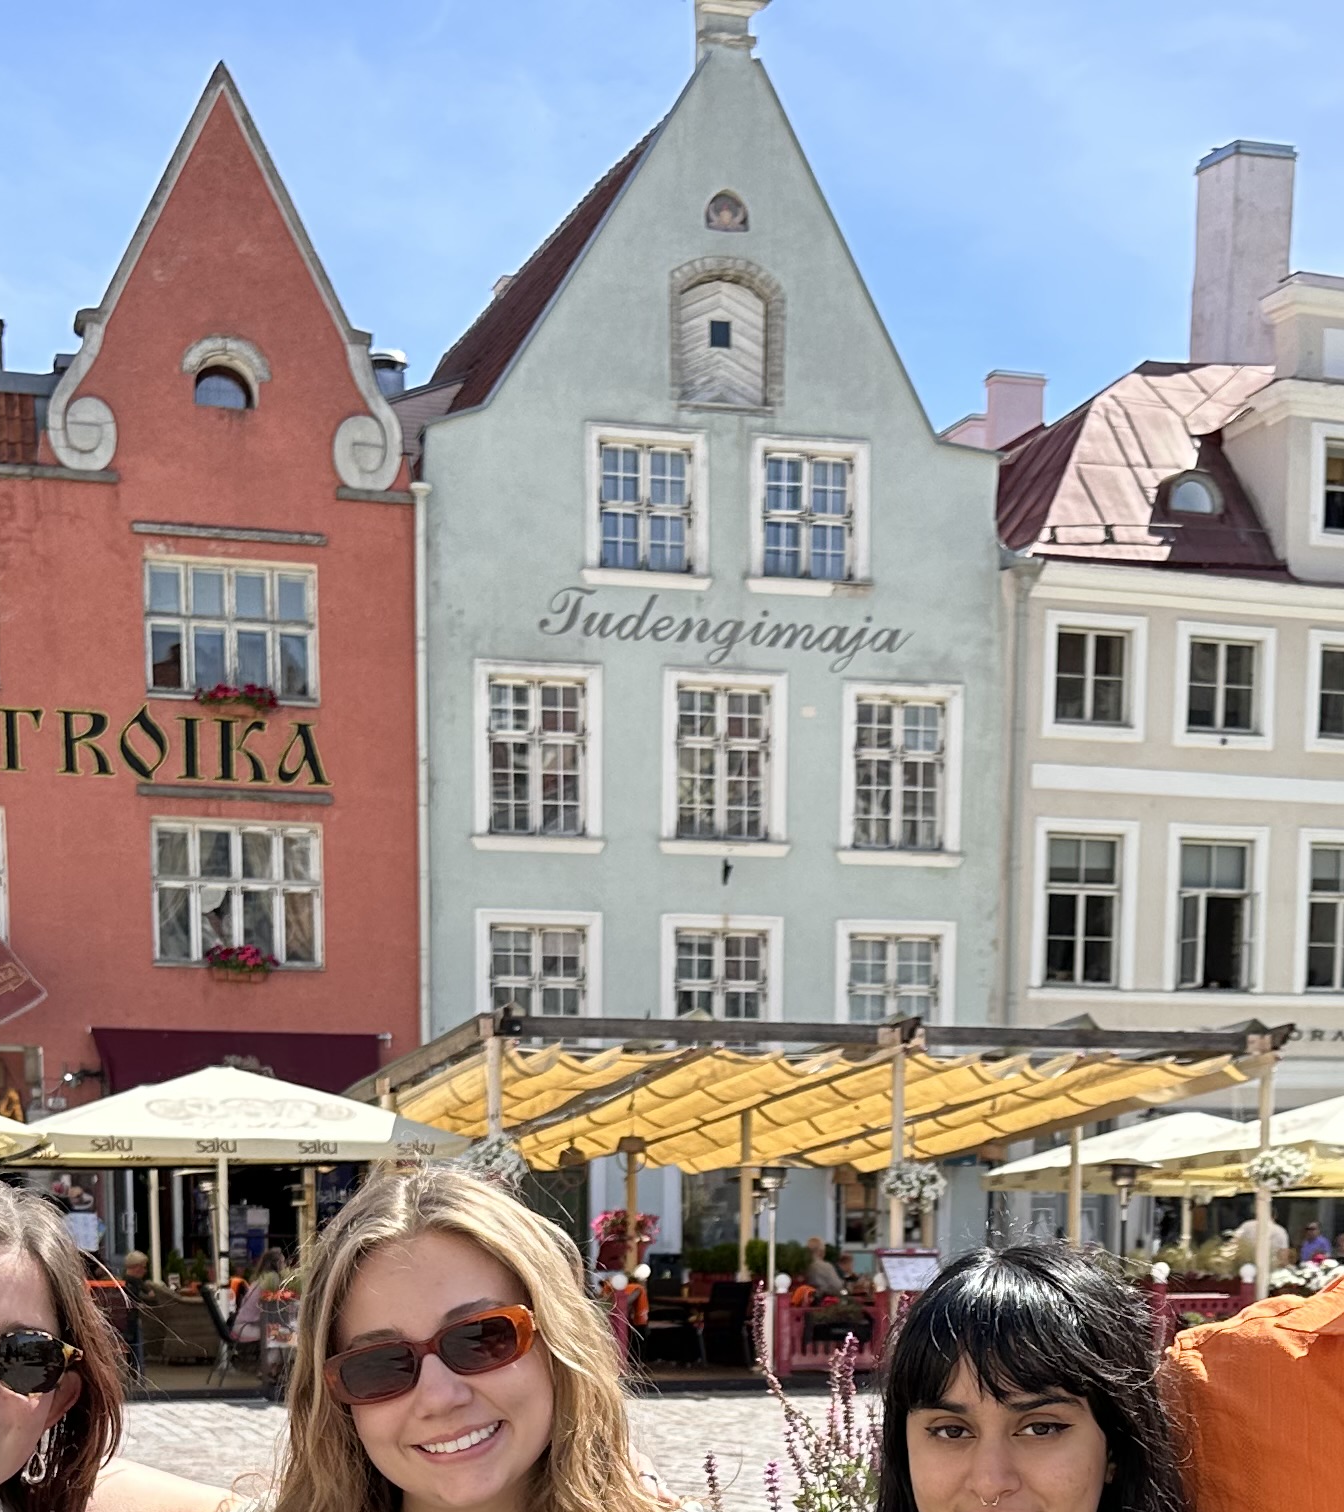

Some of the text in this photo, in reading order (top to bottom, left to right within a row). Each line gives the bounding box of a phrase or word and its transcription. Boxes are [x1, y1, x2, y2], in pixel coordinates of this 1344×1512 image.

[538, 587, 914, 673] Tudengimaja
[91, 1135, 133, 1152] saku
[196, 1137, 237, 1153] saku
[298, 1139, 338, 1154] saku
